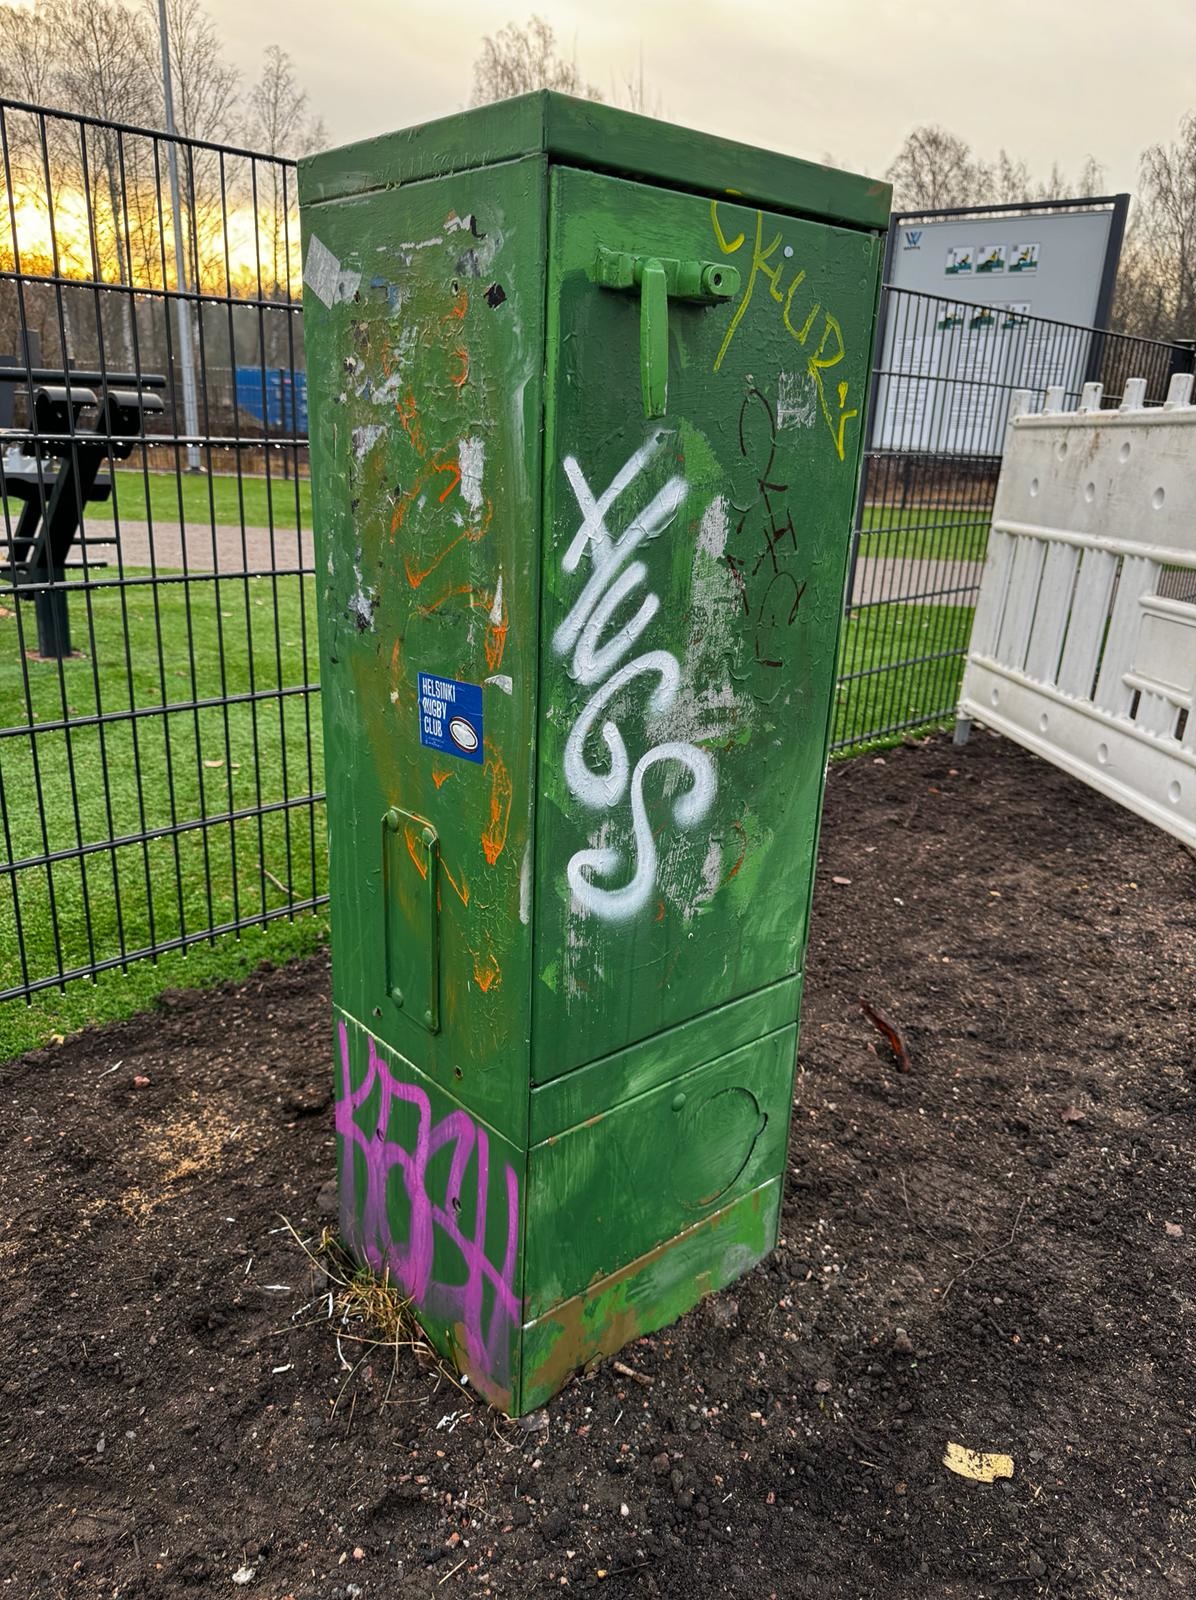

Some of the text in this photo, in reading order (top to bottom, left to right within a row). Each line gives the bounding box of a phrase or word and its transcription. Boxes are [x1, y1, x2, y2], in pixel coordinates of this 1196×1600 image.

[423, 677, 455, 703] HELSINKI
[422, 697, 447, 719] RUGBY
[424, 716, 443, 737] CLUB
